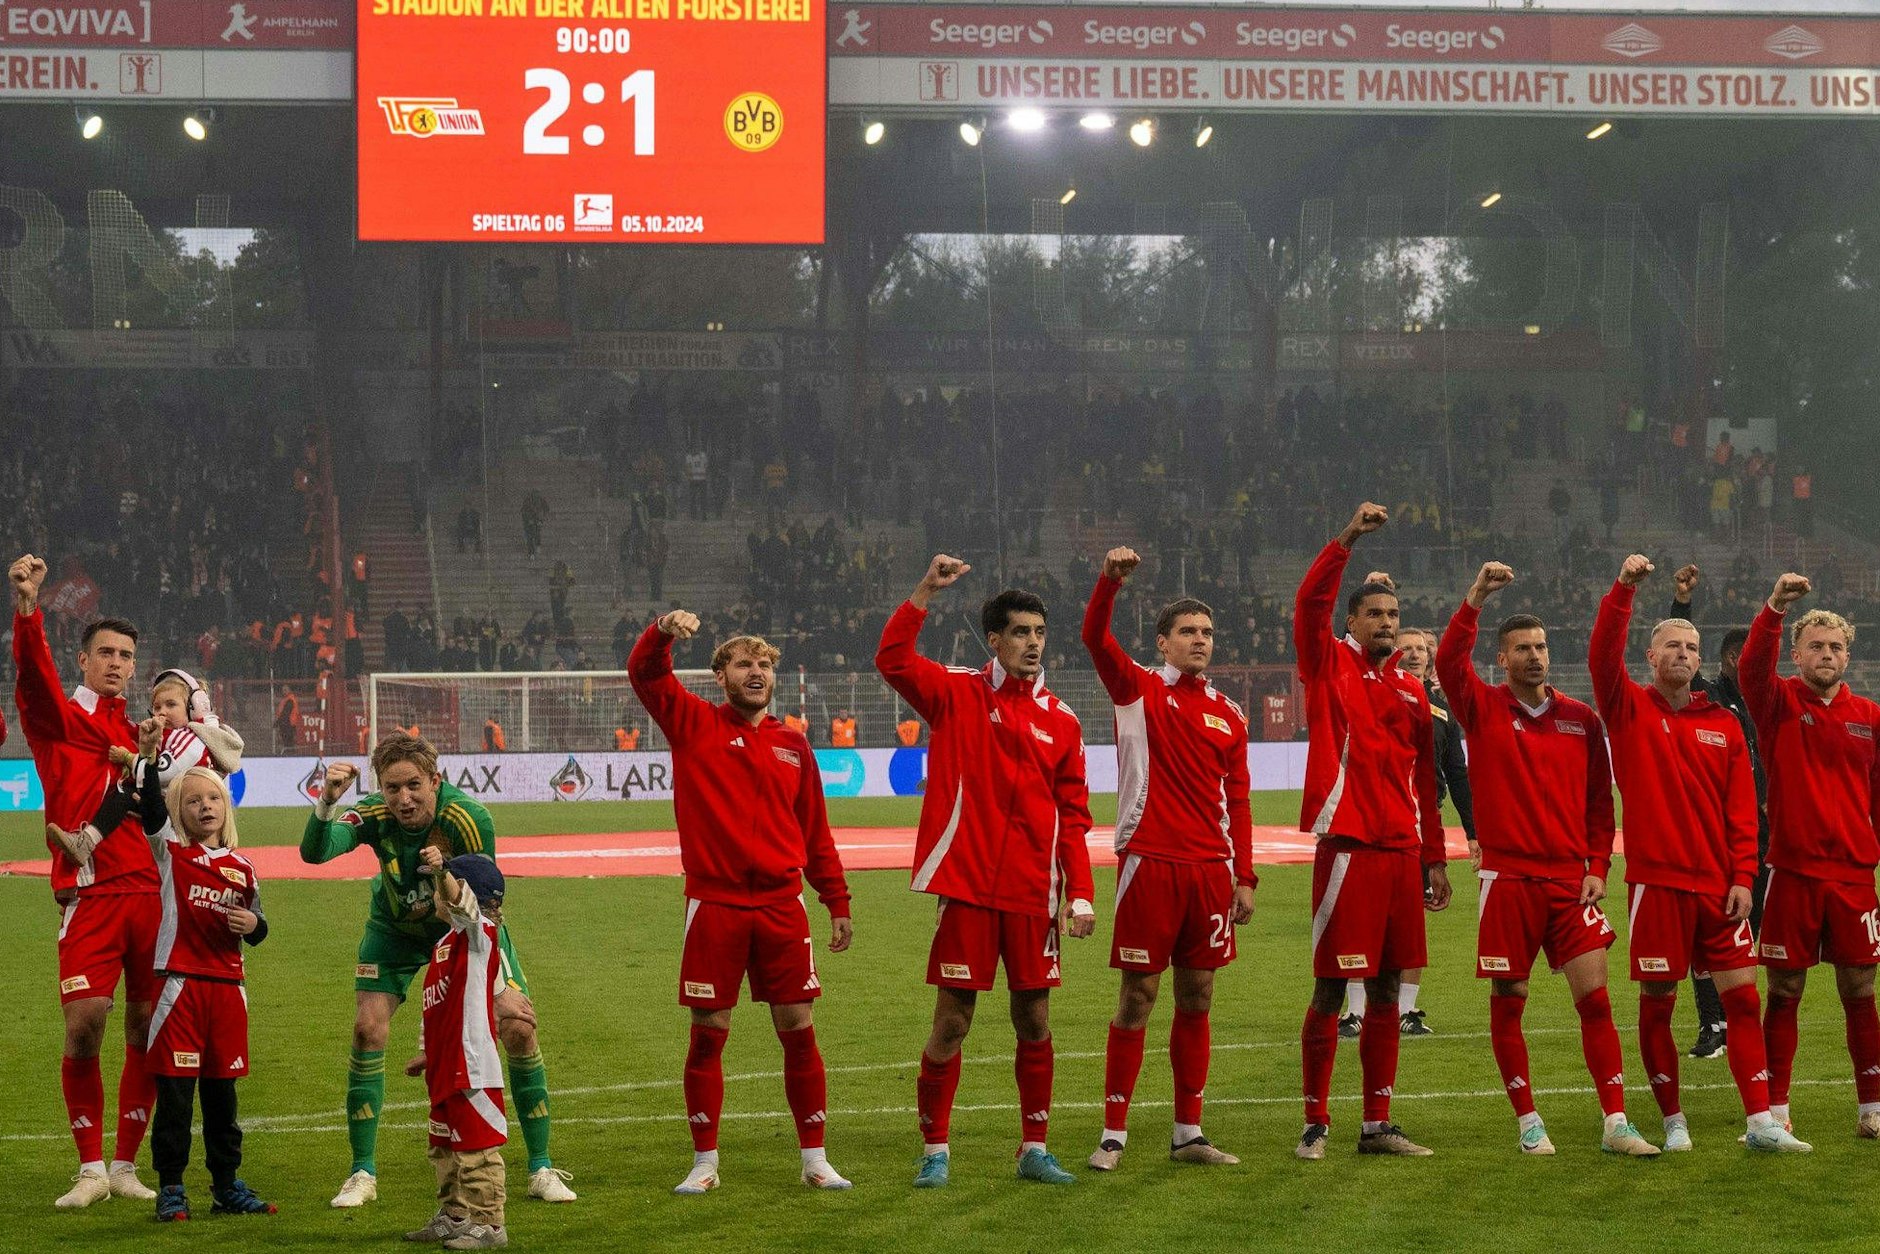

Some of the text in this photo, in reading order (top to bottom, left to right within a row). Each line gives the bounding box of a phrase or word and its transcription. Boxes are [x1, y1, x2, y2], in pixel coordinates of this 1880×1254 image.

[8, 8, 136, 36] EQVIVA
[262, 16, 338, 28] AMPELMANN
[930, 18, 1025, 46] Seeger
[1083, 19, 1178, 47] Seeger
[556, 27, 631, 54] 90:00
[1236, 22, 1328, 50] Seeger
[1386, 24, 1478, 53] Seeger
[977, 65, 1101, 99] UNSERE
[1112, 66, 1210, 101] LIEBE.
[1224, 67, 1345, 102] UNSERE
[1357, 69, 1576, 105] MANNSCHAFT.
[1589, 73, 1688, 106] UNSER
[1697, 73, 1796, 107] STOLZ.
[733, 100, 776, 132] BVB
[746, 133, 762, 144] 09
[473, 214, 566, 232] SPIELTAG 06
[621, 215, 704, 233] 05.10.2024
[1282, 337, 1330, 357] REX
[1268, 696, 1286, 708] Tor
[302, 715, 321, 727] Tor
[1271, 711, 1285, 723] 13
[606, 763, 674, 791] LAR
[1043, 927, 1059, 962] 4
